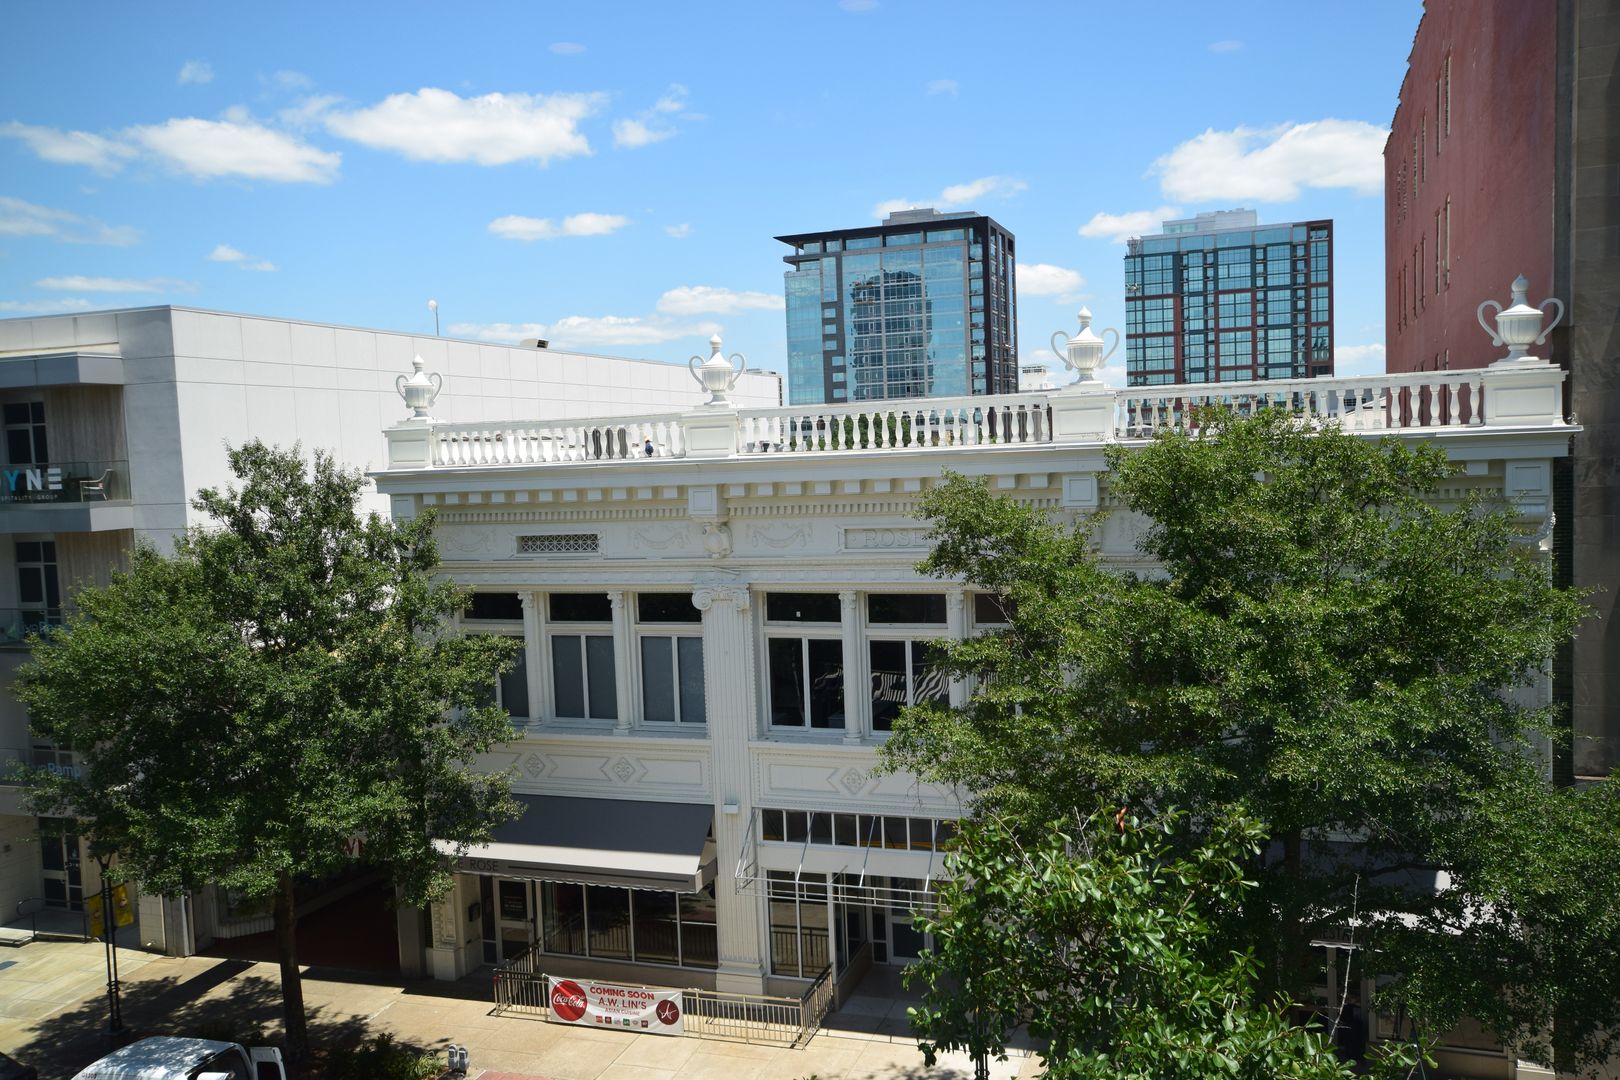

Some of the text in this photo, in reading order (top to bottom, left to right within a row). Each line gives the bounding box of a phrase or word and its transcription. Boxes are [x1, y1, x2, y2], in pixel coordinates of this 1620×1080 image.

[0, 468, 63, 491] YNE
[469, 858, 499, 872] ROSE
[590, 987, 655, 1001] COMING SOON
[598, 997, 647, 1010] A.W. LIN'S
